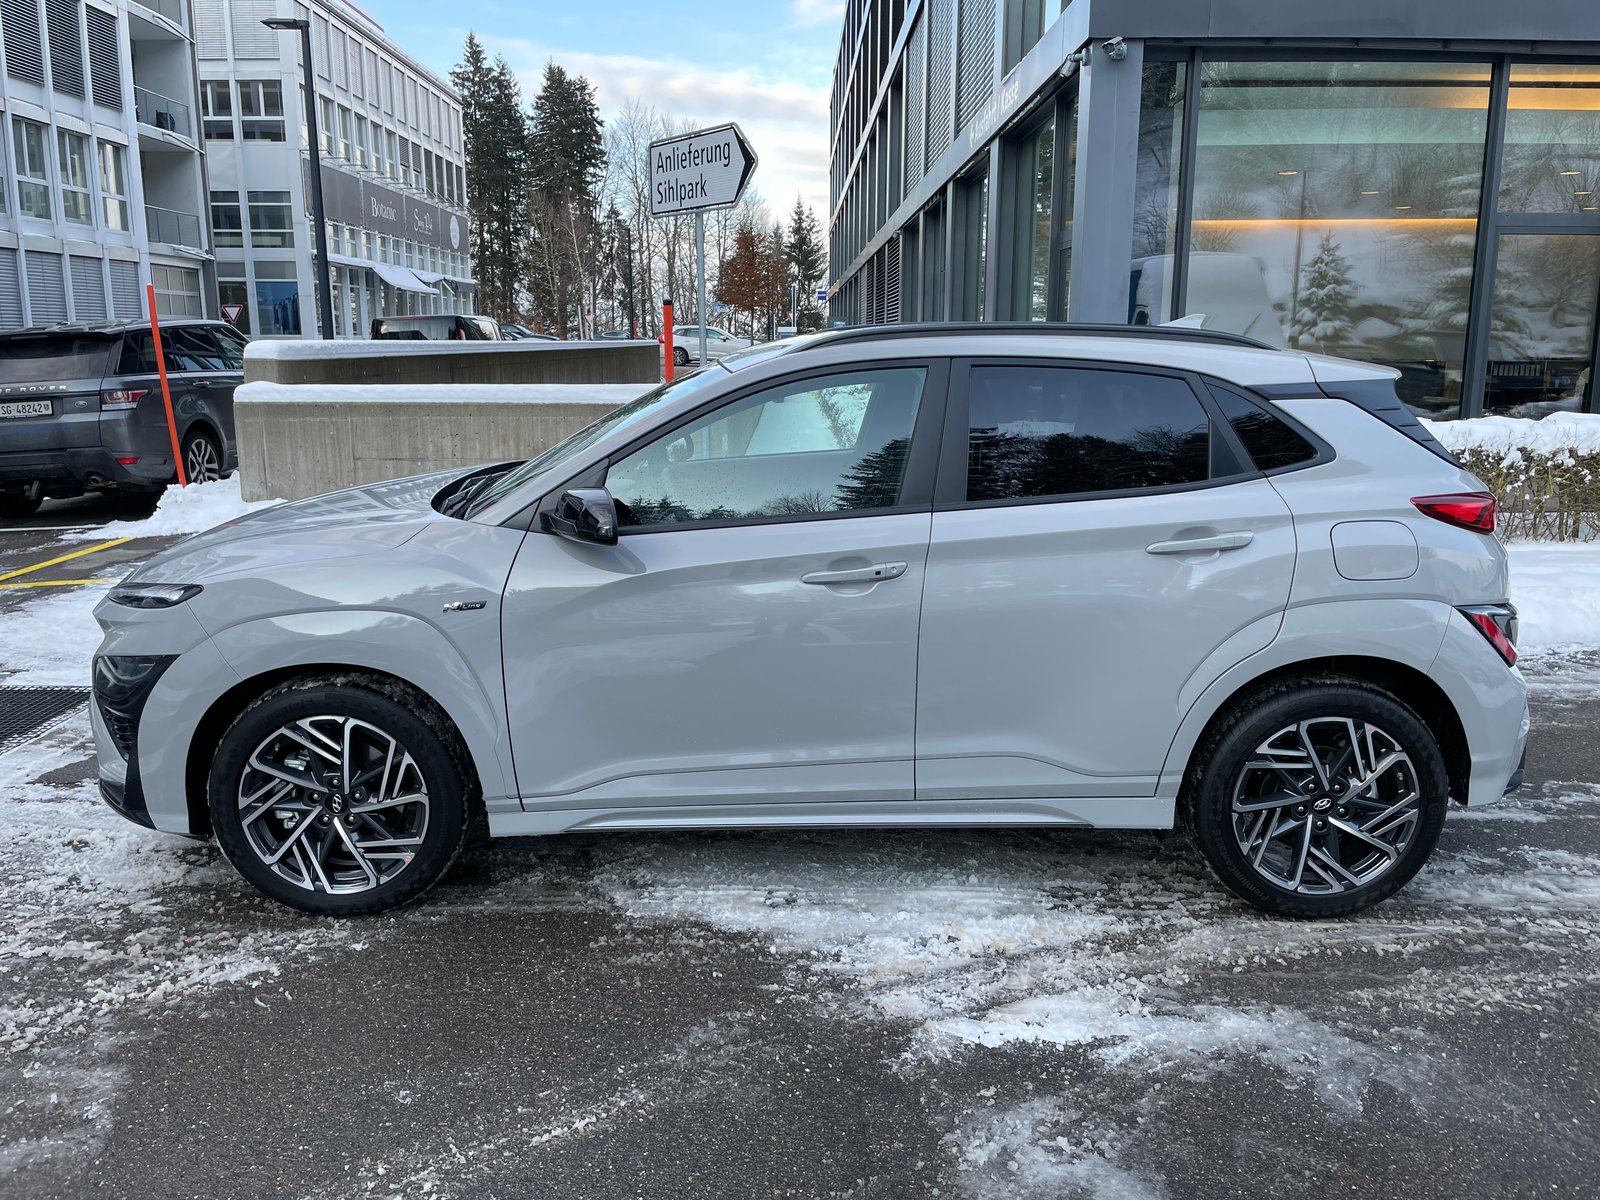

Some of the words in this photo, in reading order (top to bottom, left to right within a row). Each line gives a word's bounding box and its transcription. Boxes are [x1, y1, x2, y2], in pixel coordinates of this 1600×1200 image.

[656, 142, 731, 175] Anlieferung
[656, 173, 708, 208] Sihlpark
[370, 196, 397, 221] Botanic
